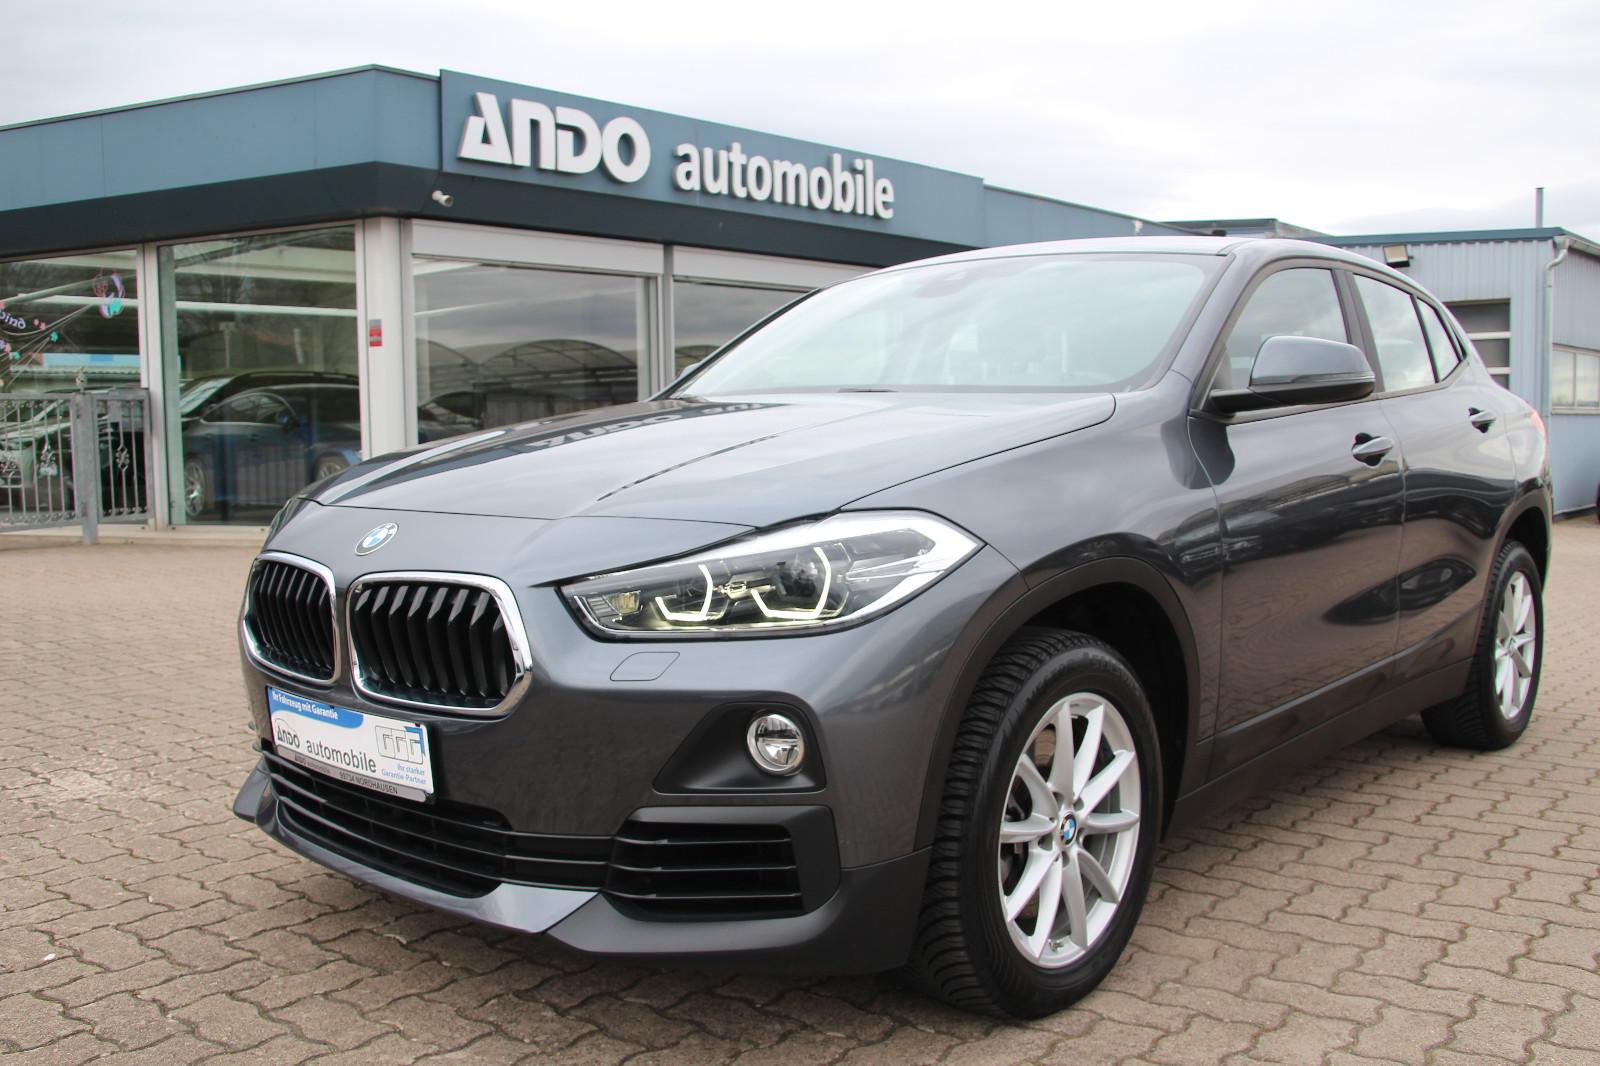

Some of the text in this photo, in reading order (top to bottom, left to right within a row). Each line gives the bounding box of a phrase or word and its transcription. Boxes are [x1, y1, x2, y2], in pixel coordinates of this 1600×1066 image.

[457, 91, 896, 220] ANDO automobile
[302, 702, 312, 713] mit
[312, 704, 339, 720] Garantie
[277, 724, 301, 749] ANDO
[306, 739, 377, 773] automobile
